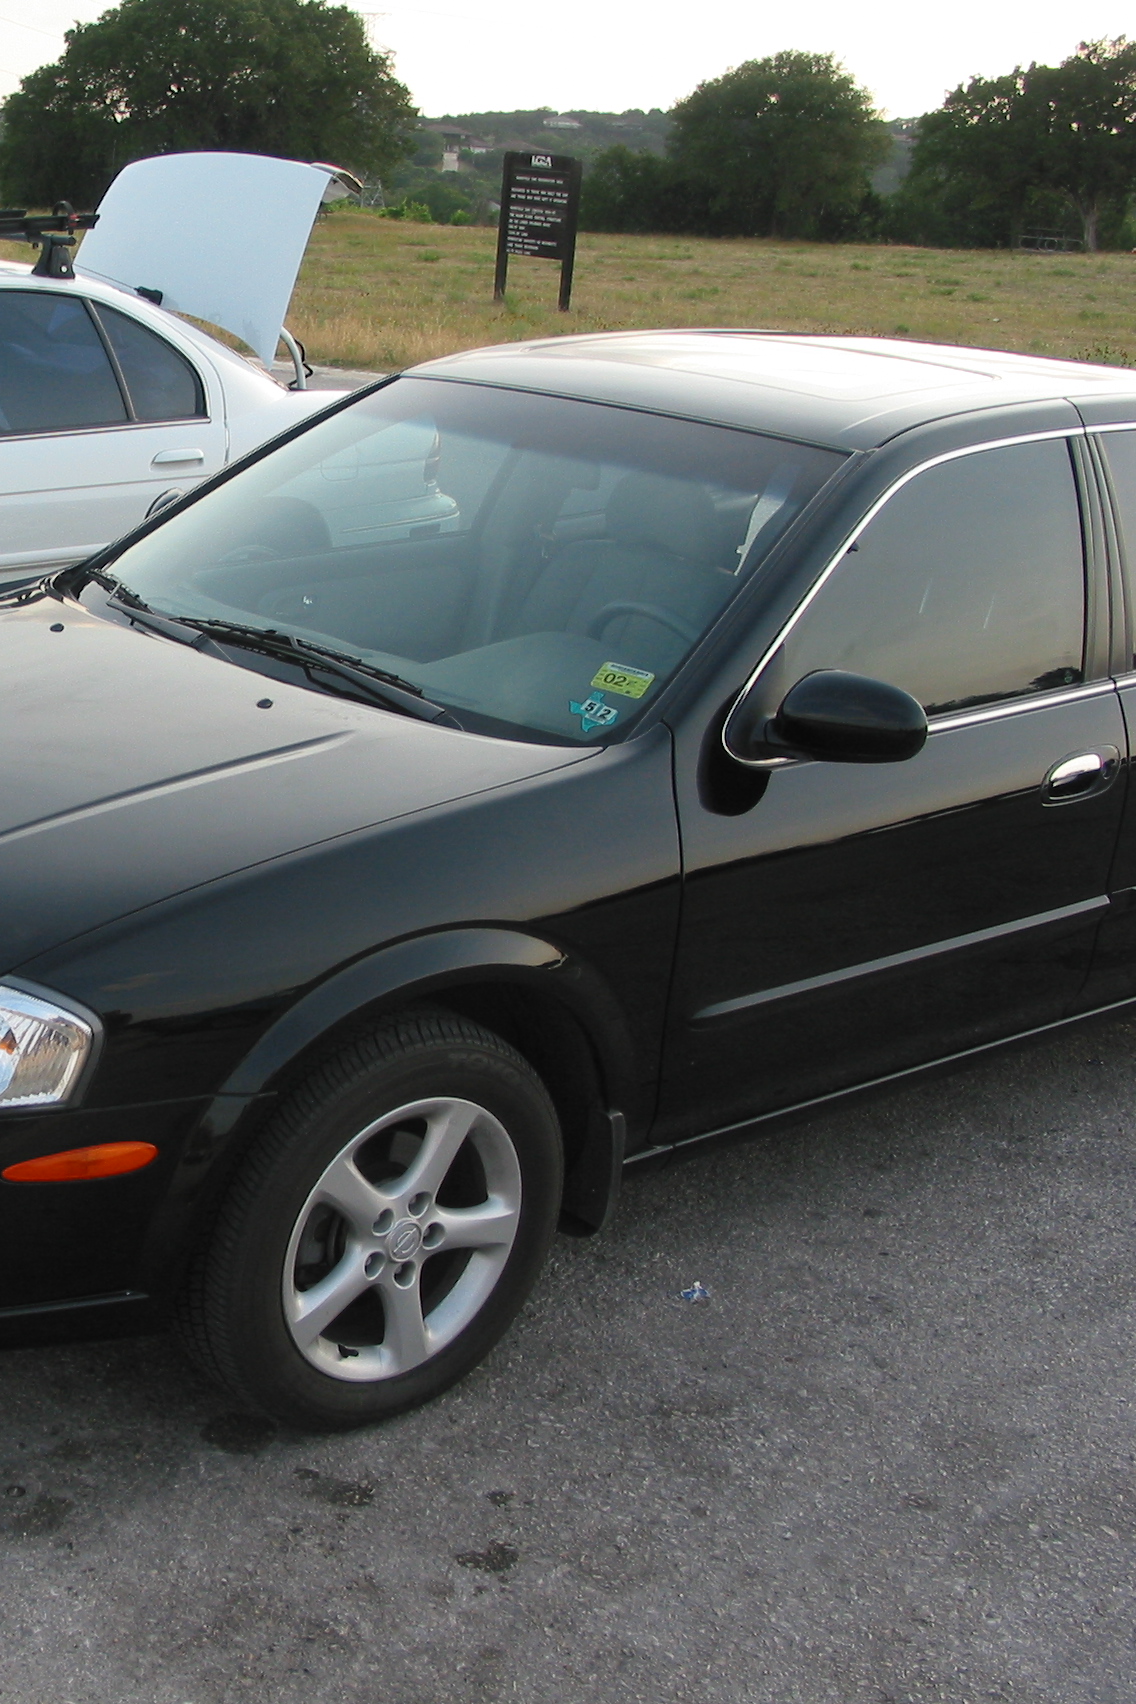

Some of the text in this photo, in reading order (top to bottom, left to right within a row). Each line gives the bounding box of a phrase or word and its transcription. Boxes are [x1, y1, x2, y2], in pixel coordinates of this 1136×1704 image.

[603, 672, 627, 687] 02
[584, 701, 612, 720] 5 2
